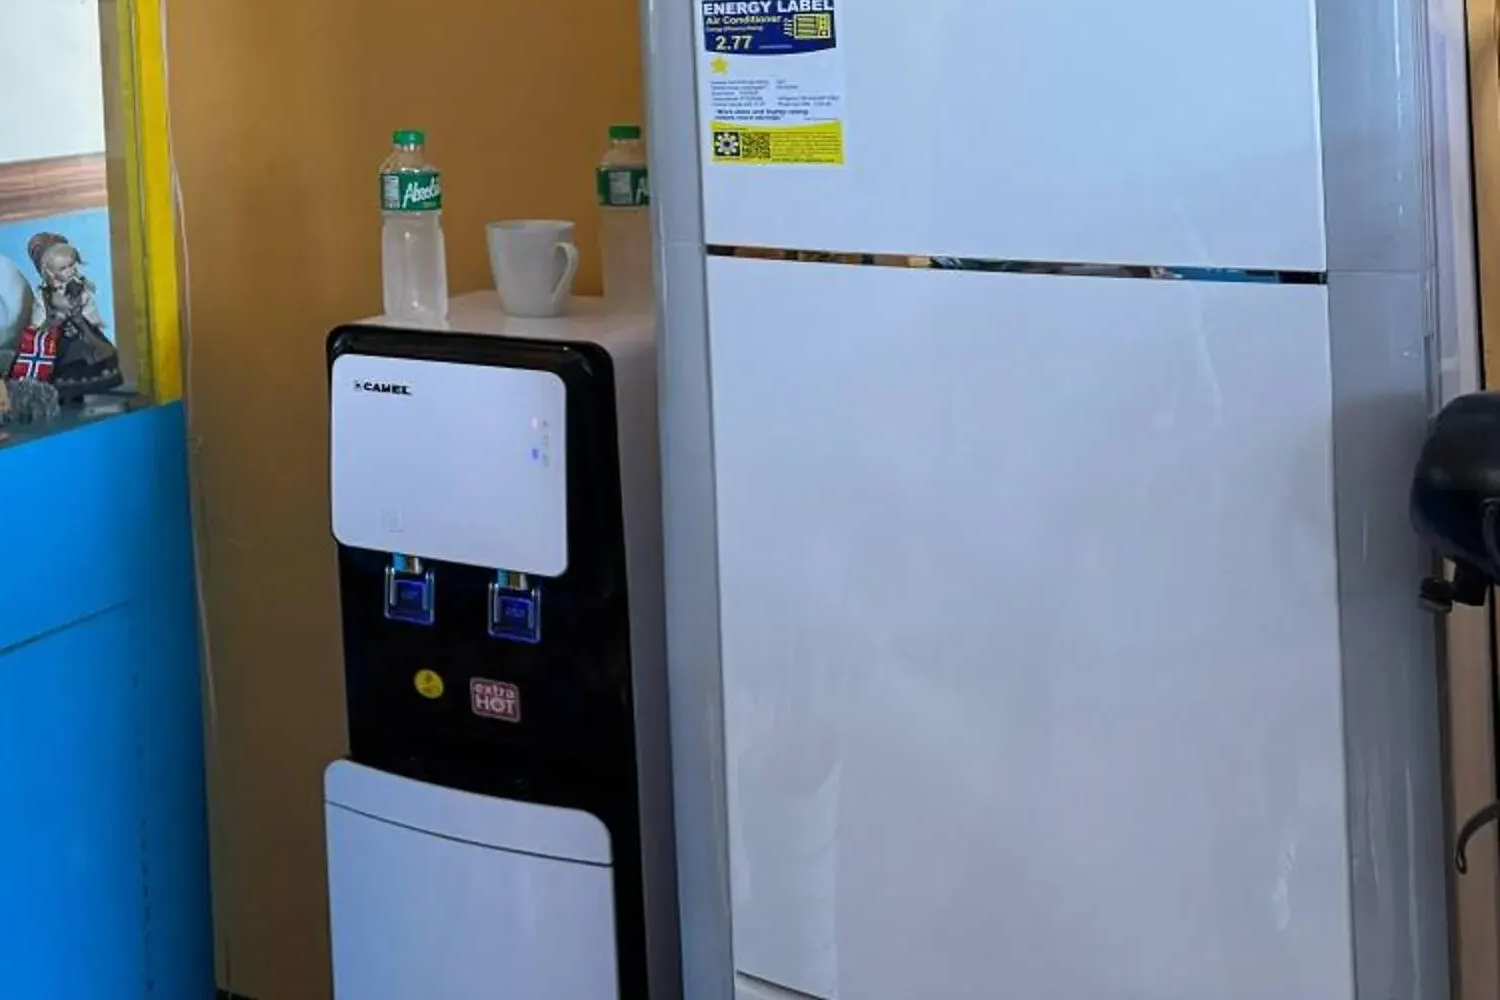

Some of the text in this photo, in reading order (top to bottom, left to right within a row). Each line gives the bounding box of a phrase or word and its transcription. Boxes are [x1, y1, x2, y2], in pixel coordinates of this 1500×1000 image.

[703, 0, 772, 16] ENERGY
[715, 35, 753, 51] 2.77
[474, 683, 515, 699] extra
[476, 694, 515, 715] HOT
